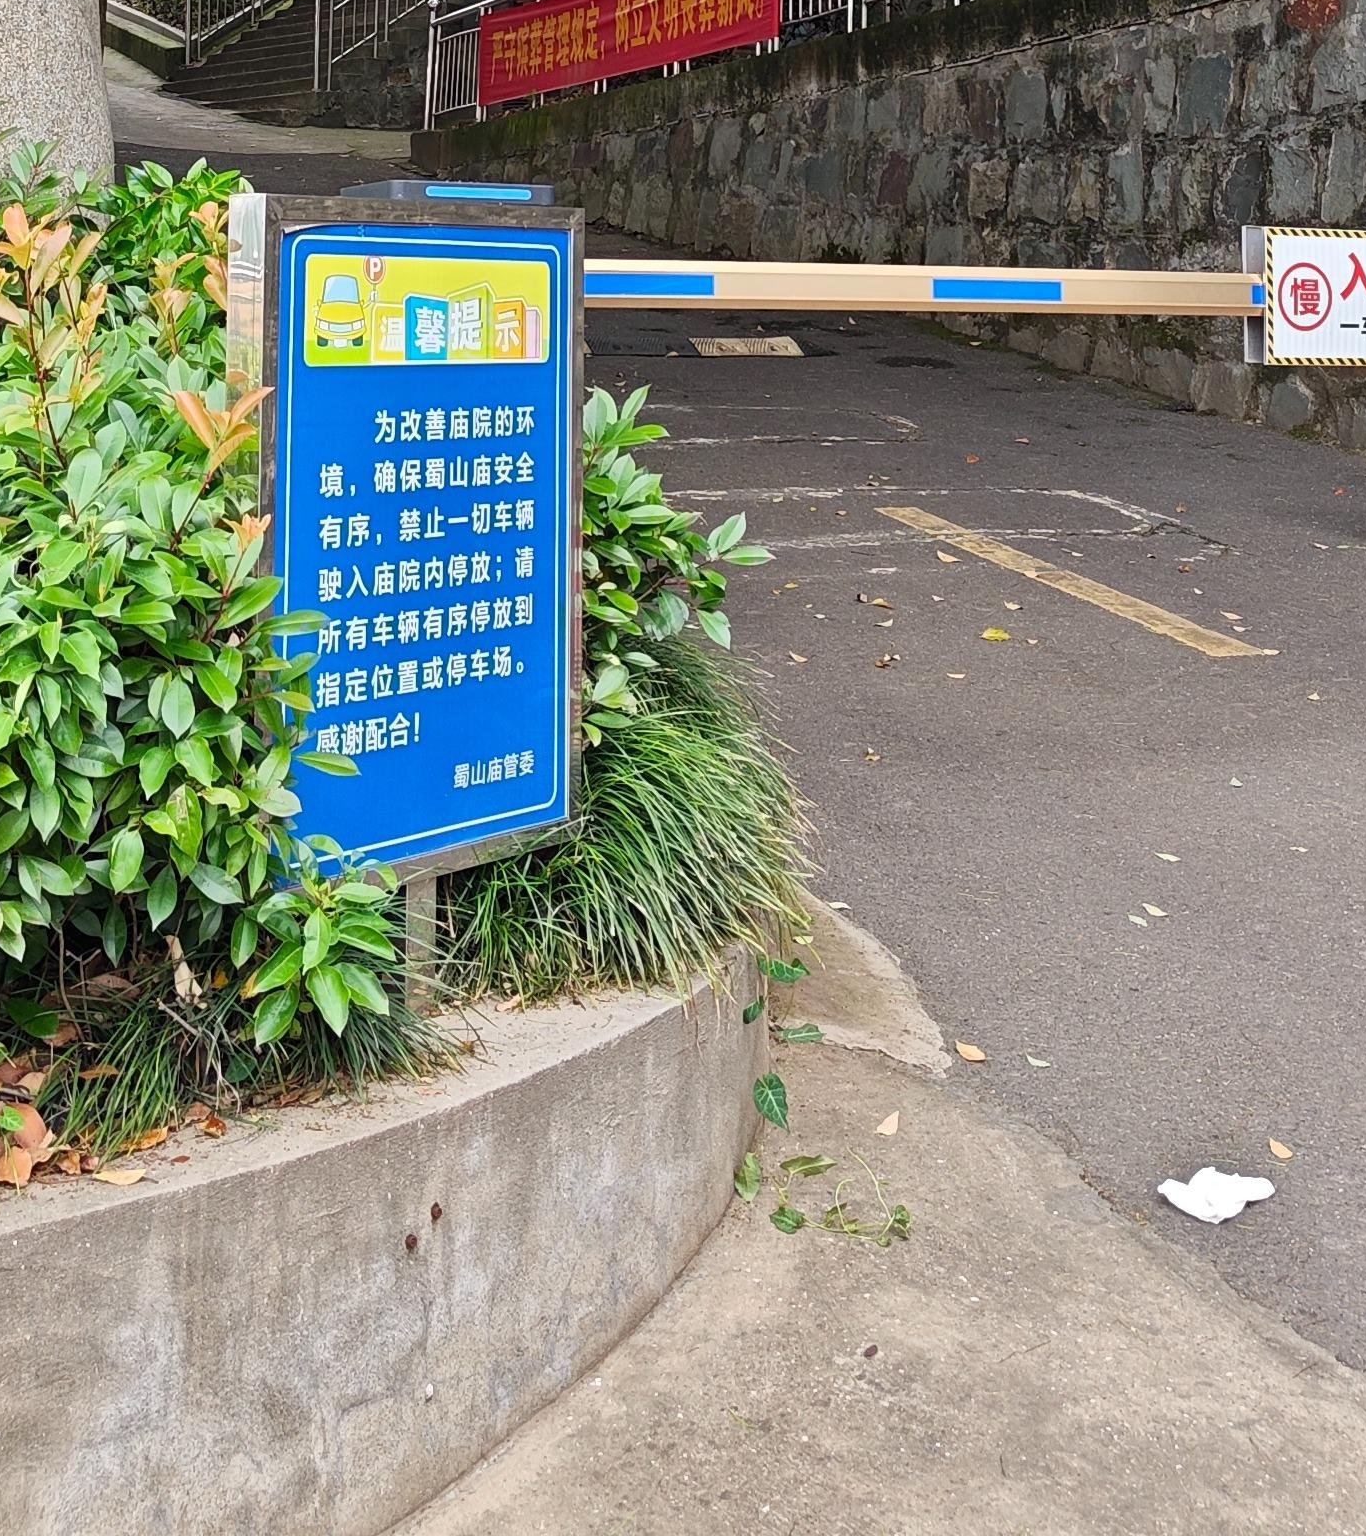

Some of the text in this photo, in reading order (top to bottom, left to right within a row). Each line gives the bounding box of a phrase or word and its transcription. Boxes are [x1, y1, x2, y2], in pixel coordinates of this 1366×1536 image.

[1290, 277, 1320, 316] 慢
[379, 297, 522, 355] 温馨提示
[374, 405, 535, 444] 为改善庙院的环
[319, 451, 535, 499] 境，确保蜀山庙安全
[319, 498, 535, 551] 有序，禁止一切车辆
[318, 545, 535, 603] 驶入庙院内停放；请
[317, 593, 534, 655] 所有车辆有序停放到
[316, 645, 525, 709] 指定位置或停车场。
[453, 750, 535, 789] 蜀山庙管委
